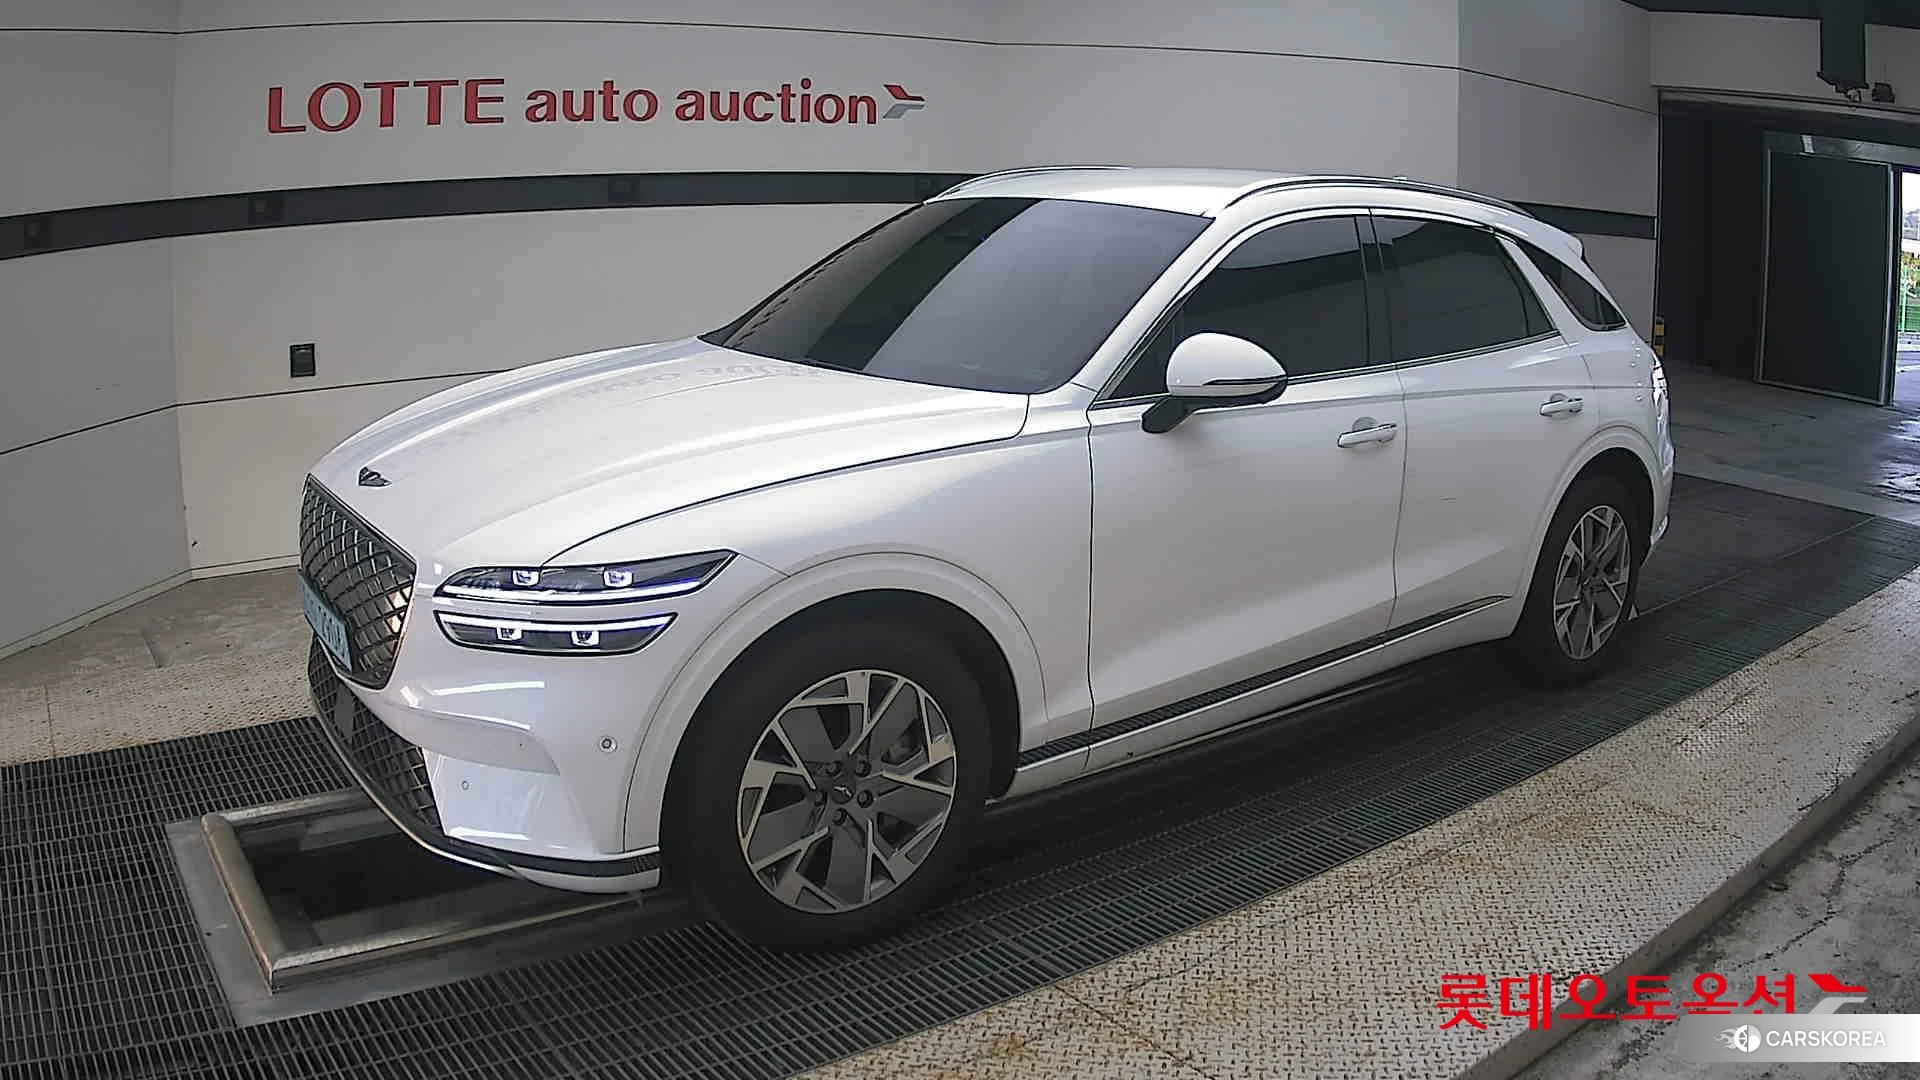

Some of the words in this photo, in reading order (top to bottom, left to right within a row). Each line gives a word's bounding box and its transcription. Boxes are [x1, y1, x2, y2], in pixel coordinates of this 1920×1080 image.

[269, 79, 504, 133] LOTTE
[526, 80, 657, 123] auto
[676, 79, 877, 124] auction
